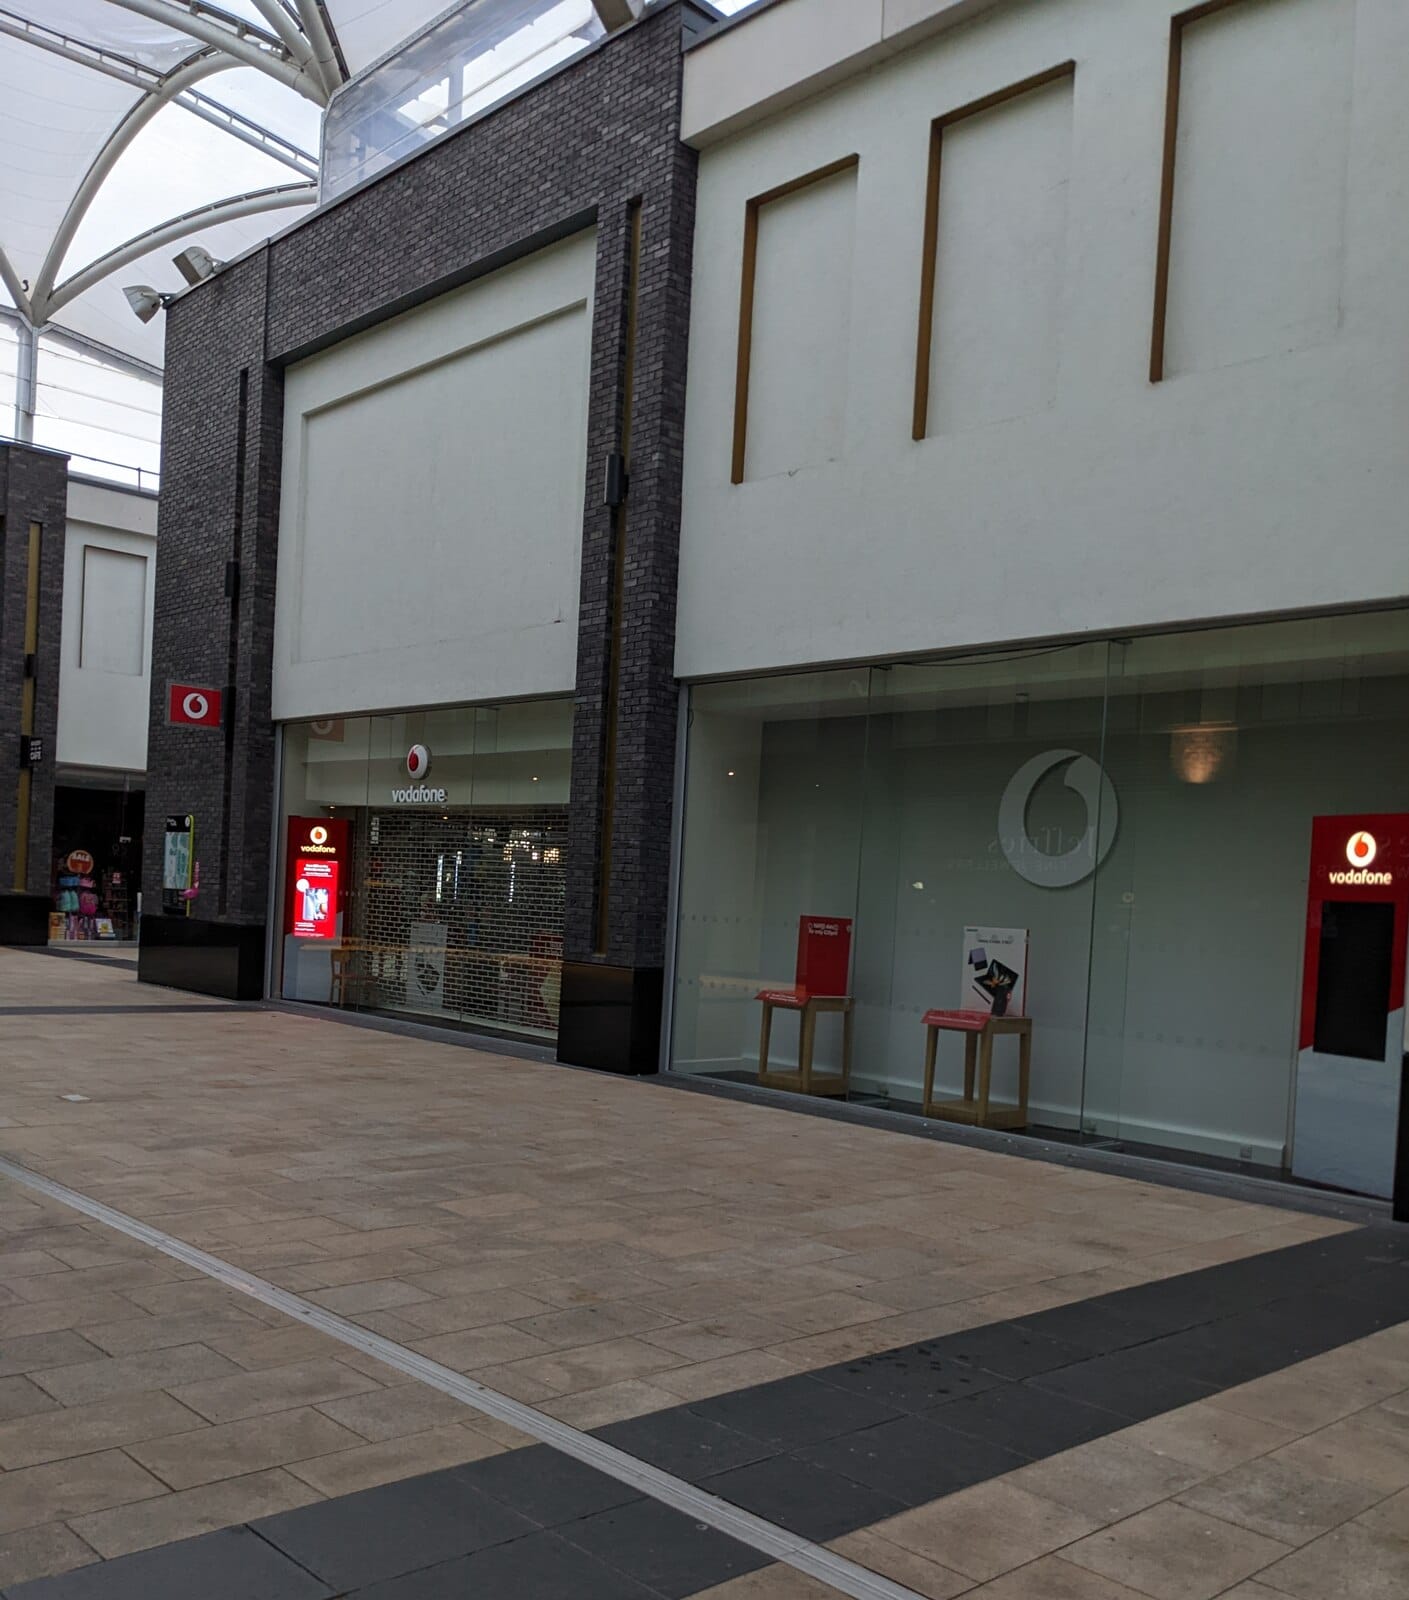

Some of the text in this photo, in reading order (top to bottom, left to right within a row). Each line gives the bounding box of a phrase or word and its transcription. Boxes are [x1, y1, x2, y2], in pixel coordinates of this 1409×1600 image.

[392, 785, 446, 803] vodafone
[300, 844, 336, 854] vodafone
[1328, 868, 1393, 885] vodafone
